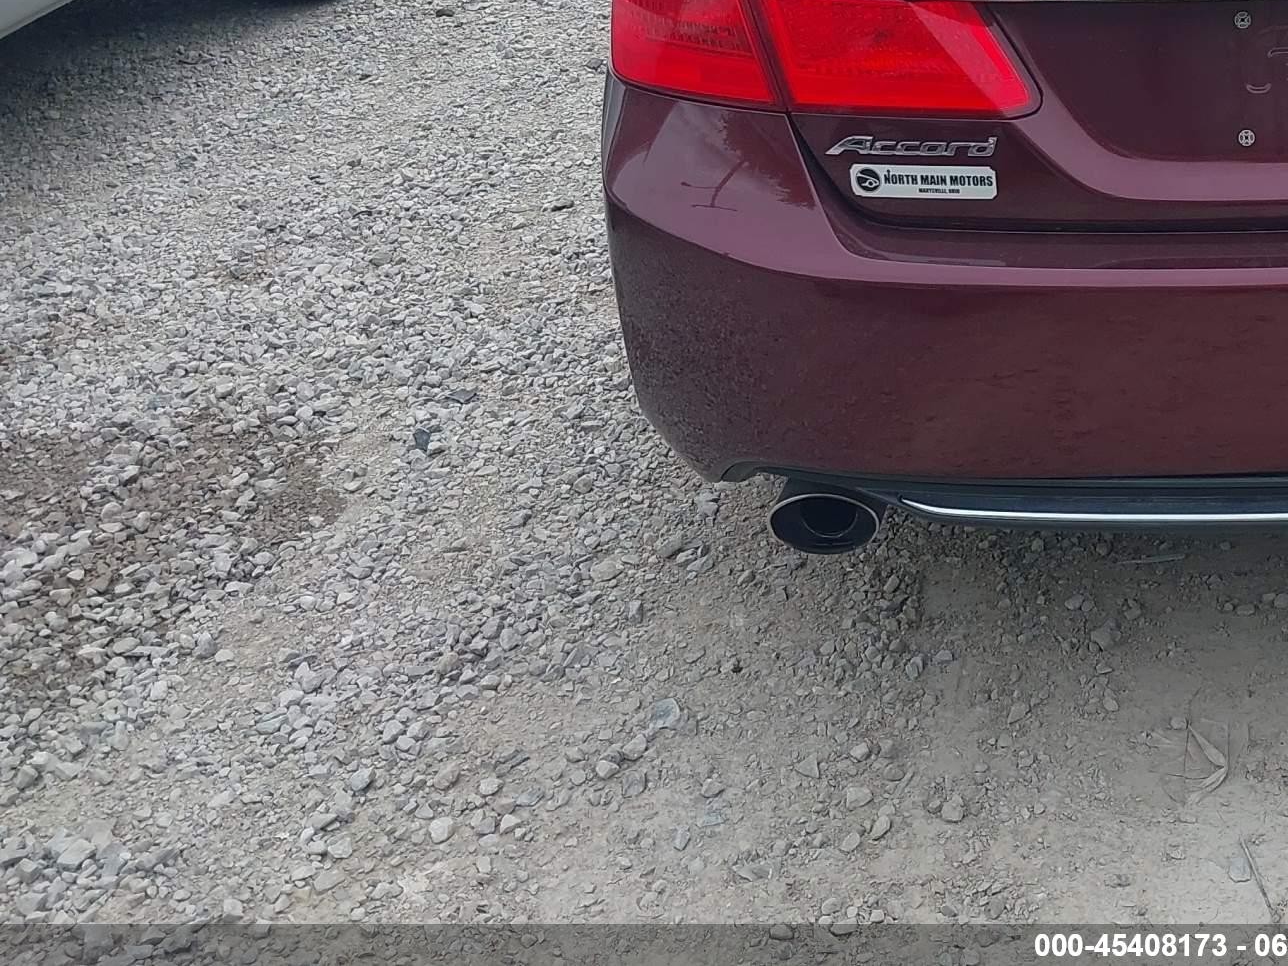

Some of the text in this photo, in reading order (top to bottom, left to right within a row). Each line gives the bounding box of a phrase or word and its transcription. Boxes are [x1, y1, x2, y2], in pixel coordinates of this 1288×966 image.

[825, 135, 998, 157] Accord
[883, 171, 993, 187] NORTH MAIN MOTORS
